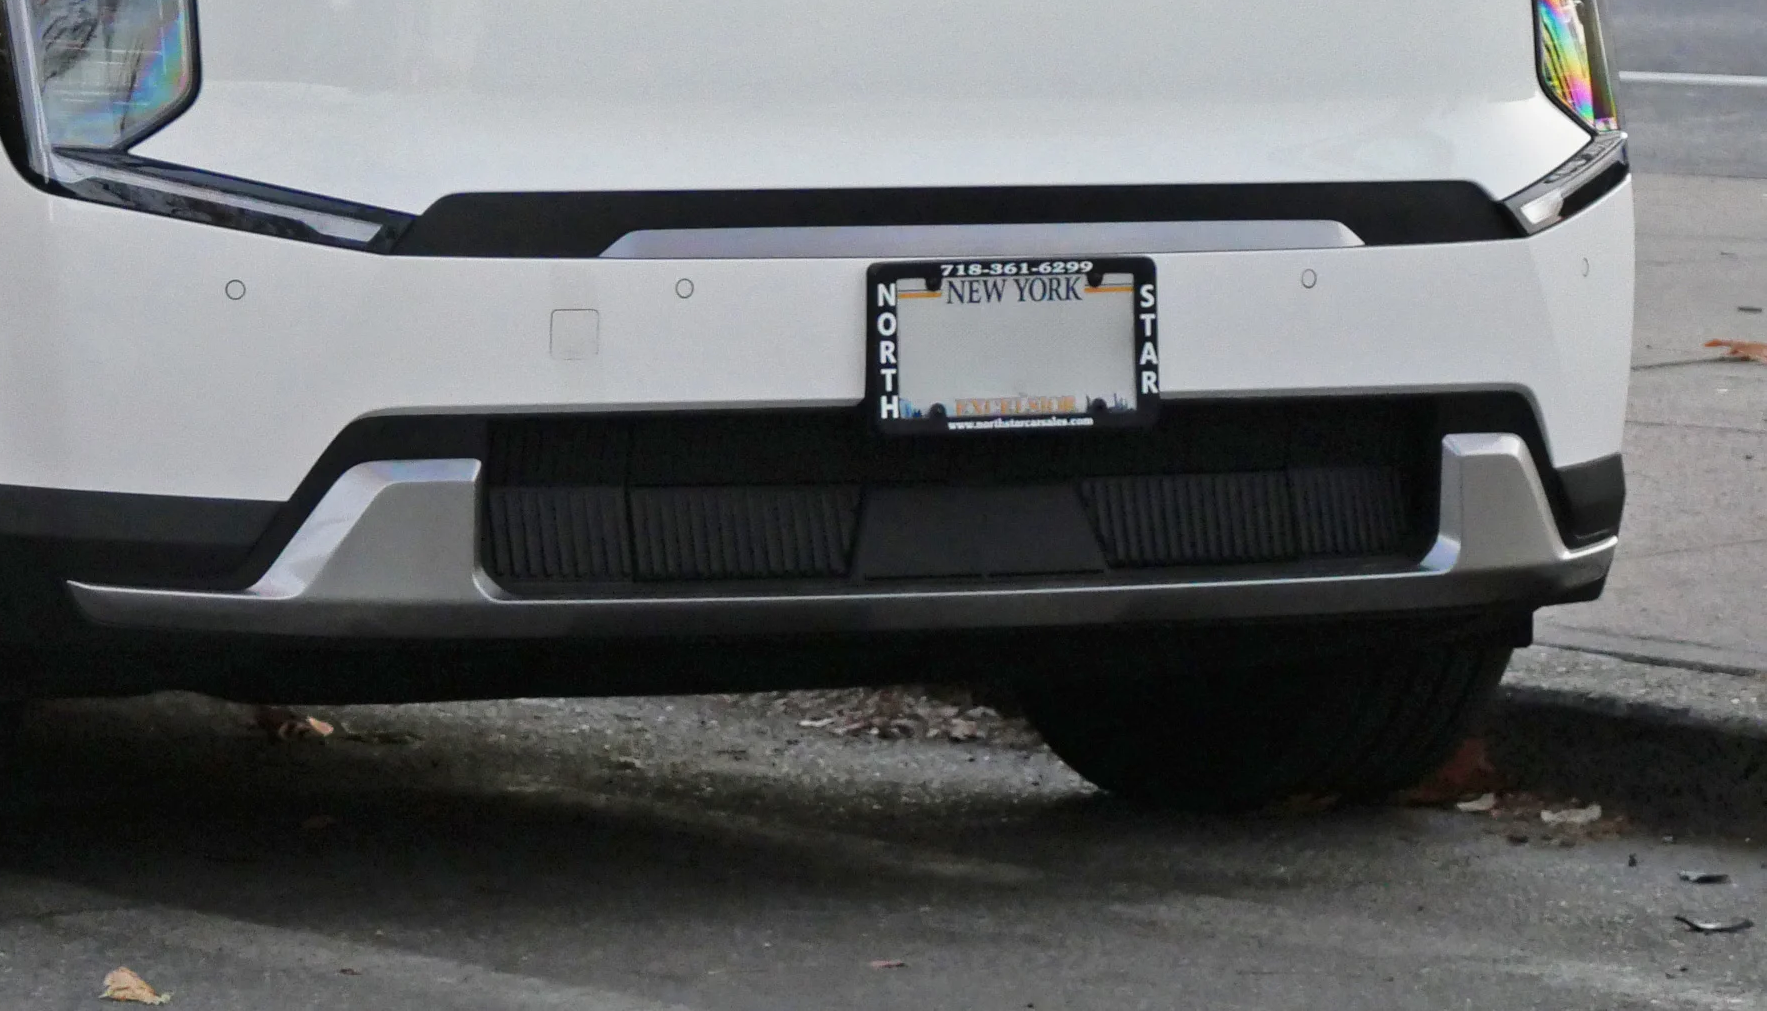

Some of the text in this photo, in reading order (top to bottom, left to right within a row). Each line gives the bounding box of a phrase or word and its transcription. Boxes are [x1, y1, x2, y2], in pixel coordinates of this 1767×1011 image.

[941, 260, 1094, 277] 718-361-6299
[946, 276, 1083, 305] NEW YORK
[877, 283, 900, 419] NORTH
[1139, 284, 1159, 395] STAR
[948, 416, 1094, 431] www.northstarcarsales.com
